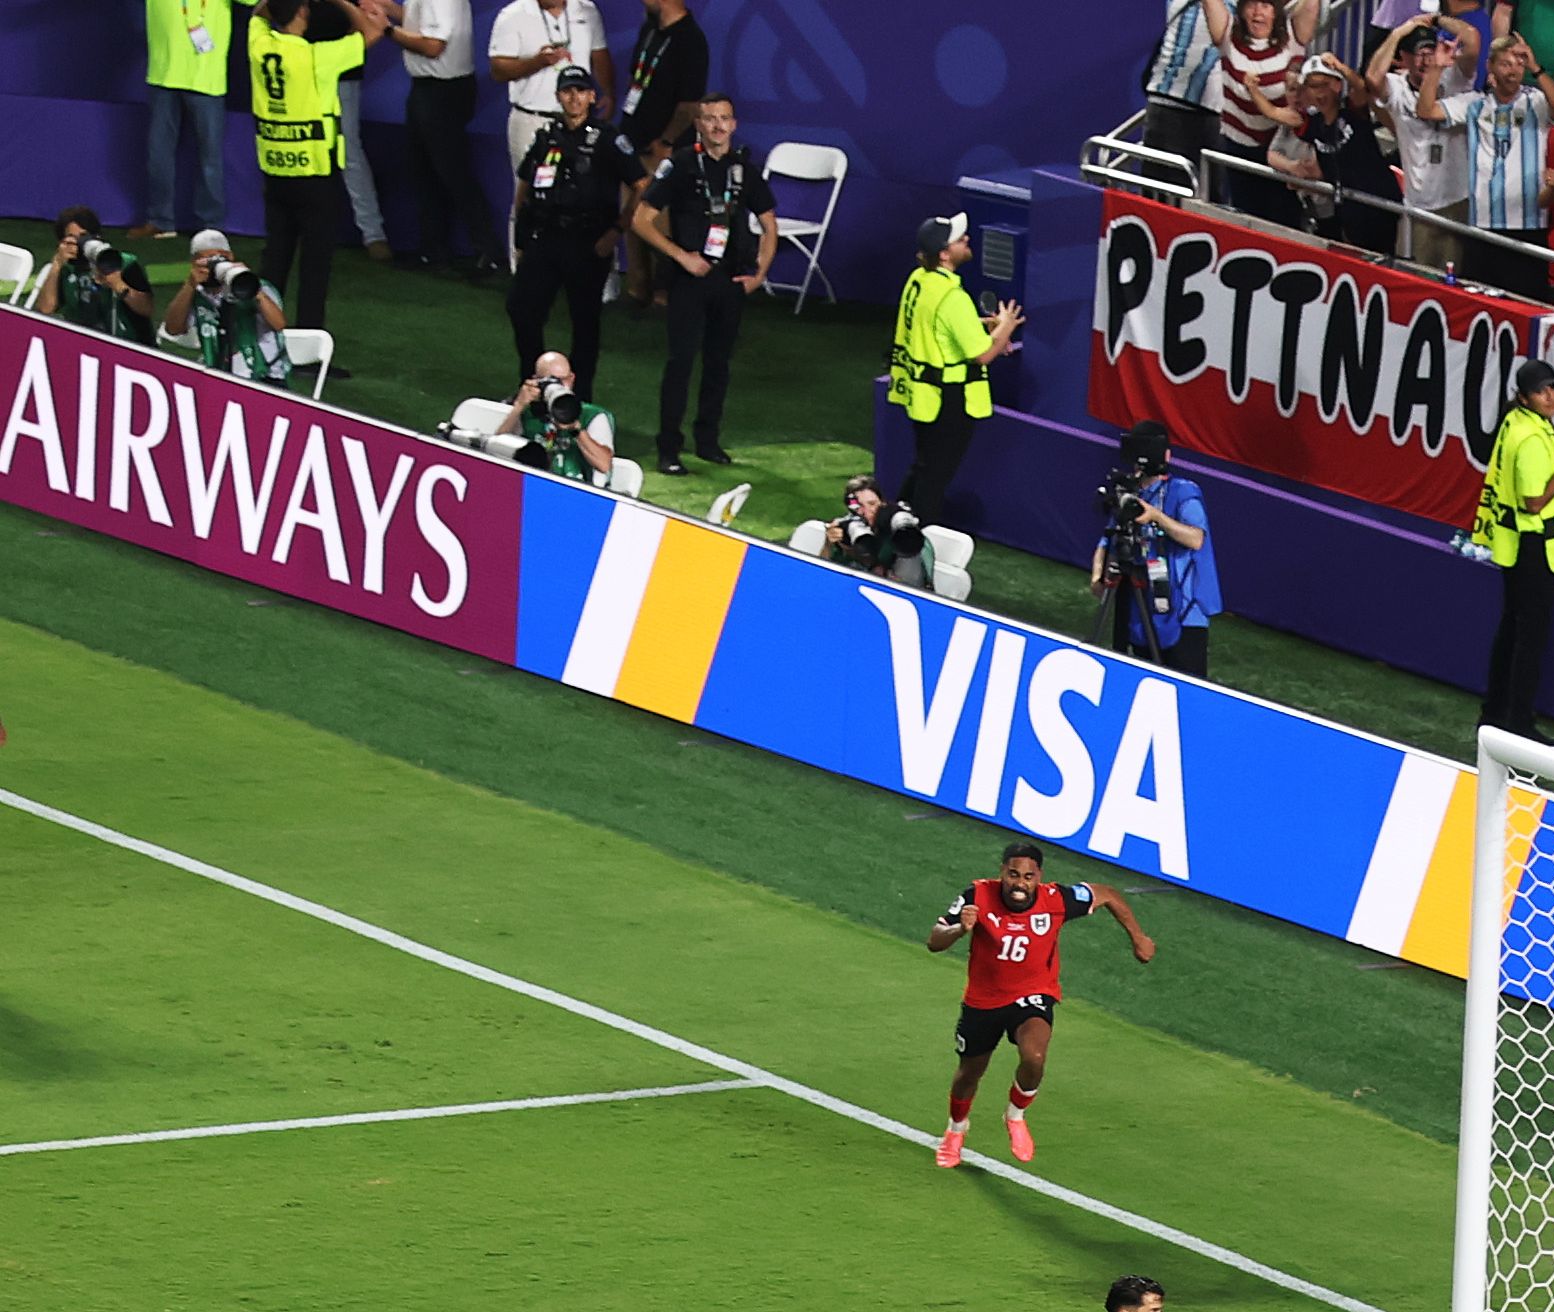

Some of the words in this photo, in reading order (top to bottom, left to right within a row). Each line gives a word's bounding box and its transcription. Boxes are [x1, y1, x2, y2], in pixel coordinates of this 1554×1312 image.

[0, 336, 469, 618] AIRWAYS
[1105, 216, 1517, 473] PETTNAU
[858, 585, 1190, 881] VISA
[997, 935, 1030, 962] 16
